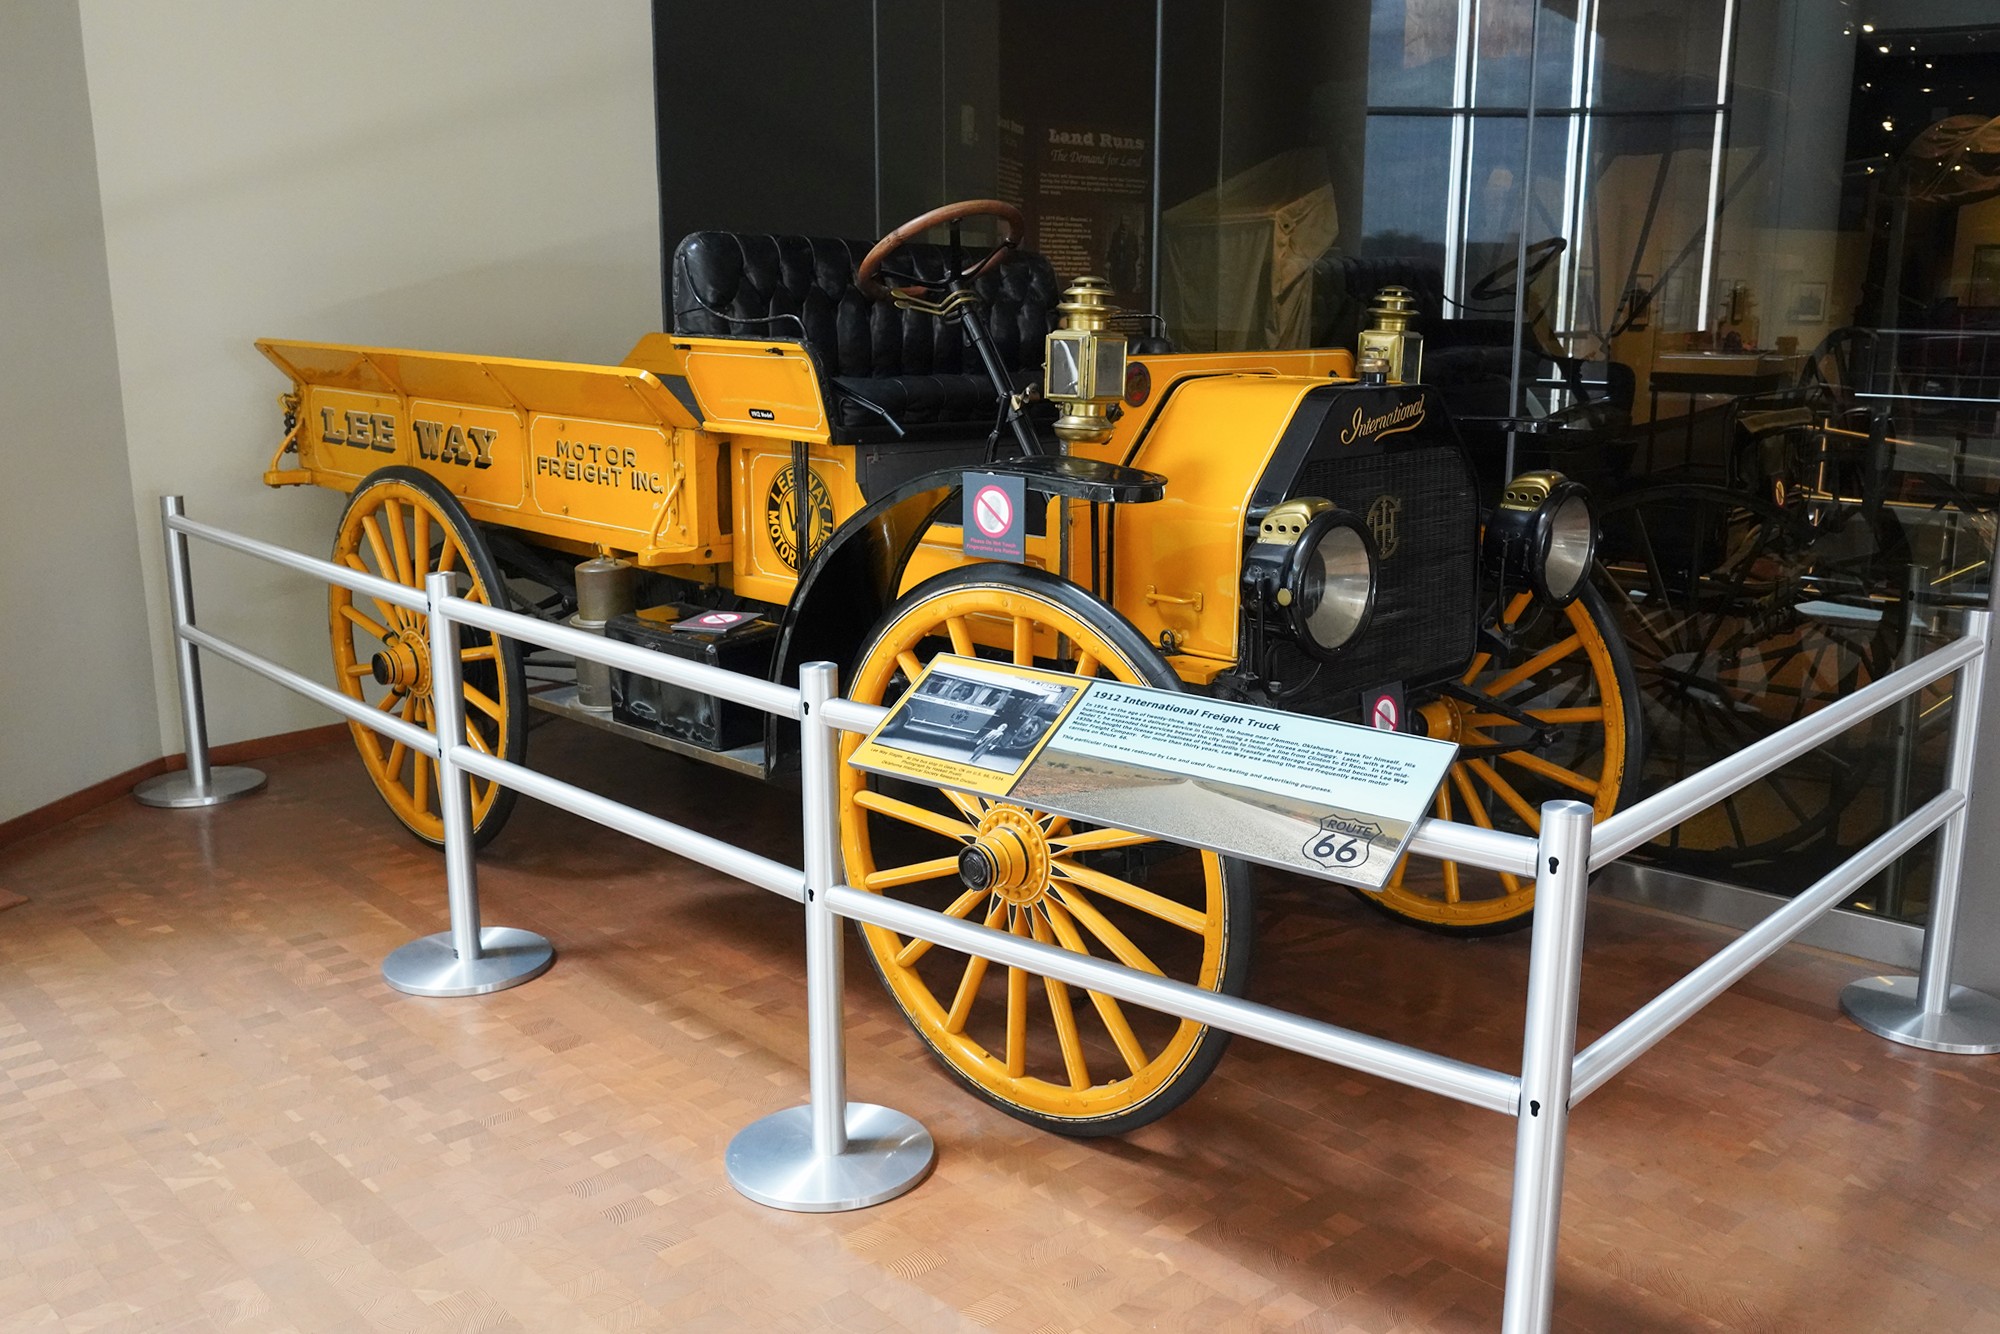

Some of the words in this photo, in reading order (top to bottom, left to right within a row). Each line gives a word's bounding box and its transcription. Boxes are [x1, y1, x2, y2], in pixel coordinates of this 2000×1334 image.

[1048, 128, 1094, 146] Land
[1100, 133, 1144, 150] Runs
[320, 406, 396, 453] LEE
[413, 420, 498, 470] WAY
[1340, 393, 1426, 445] International
[537, 456, 622, 487] FREIGHT
[631, 470, 664, 494] INC.
[556, 438, 636, 468] MOTOR
[768, 510, 796, 567] MOTOR
[1081, 706, 1106, 714] business
[1147, 719, 1171, 727] delivery
[1201, 729, 1224, 738] Clinton,
[1274, 743, 1296, 751] horses
[1315, 751, 1338, 759] buggy.
[1341, 756, 1361, 764] Later,
[1093, 691, 1121, 701] 1912
[1122, 696, 1199, 716] International
[1200, 710, 1244, 724] Freight
[1247, 718, 1280, 731] Truck
[1073, 737, 1102, 745] particular
[1131, 748, 1157, 757] restored
[1216, 766, 1249, 776] marketing
[1262, 775, 1299, 787] advertising
[1299, 783, 1330, 792] purposes.
[1088, 723, 1110, 731] Freight
[1110, 727, 1137, 737] Company.
[1262, 758, 1284, 766] among
[1314, 768, 1349, 779] frequently
[1101, 720, 1122, 728] bought
[1166, 733, 1192, 742] business
[1212, 742, 1238, 751] Amarillo
[1239, 747, 1266, 756] Transfer
[1279, 755, 1305, 764] Storage
[1306, 760, 1336, 771] Company
[1351, 769, 1378, 778] become
[1110, 718, 1139, 726] expanded
[1149, 725, 1173, 733] services
[1173, 729, 1197, 737] beyond
[1247, 743, 1270, 752] include
[1307, 755, 1330, 763] Clinton
[1146, 713, 1185, 725] twenty-three,
[1270, 737, 1299, 747] Hammon,
[1301, 742, 1334, 752] Oklahoma
[1373, 756, 1400, 765] himself.
[1313, 834, 1358, 862] 66
[1327, 820, 1372, 836] ROUTE
